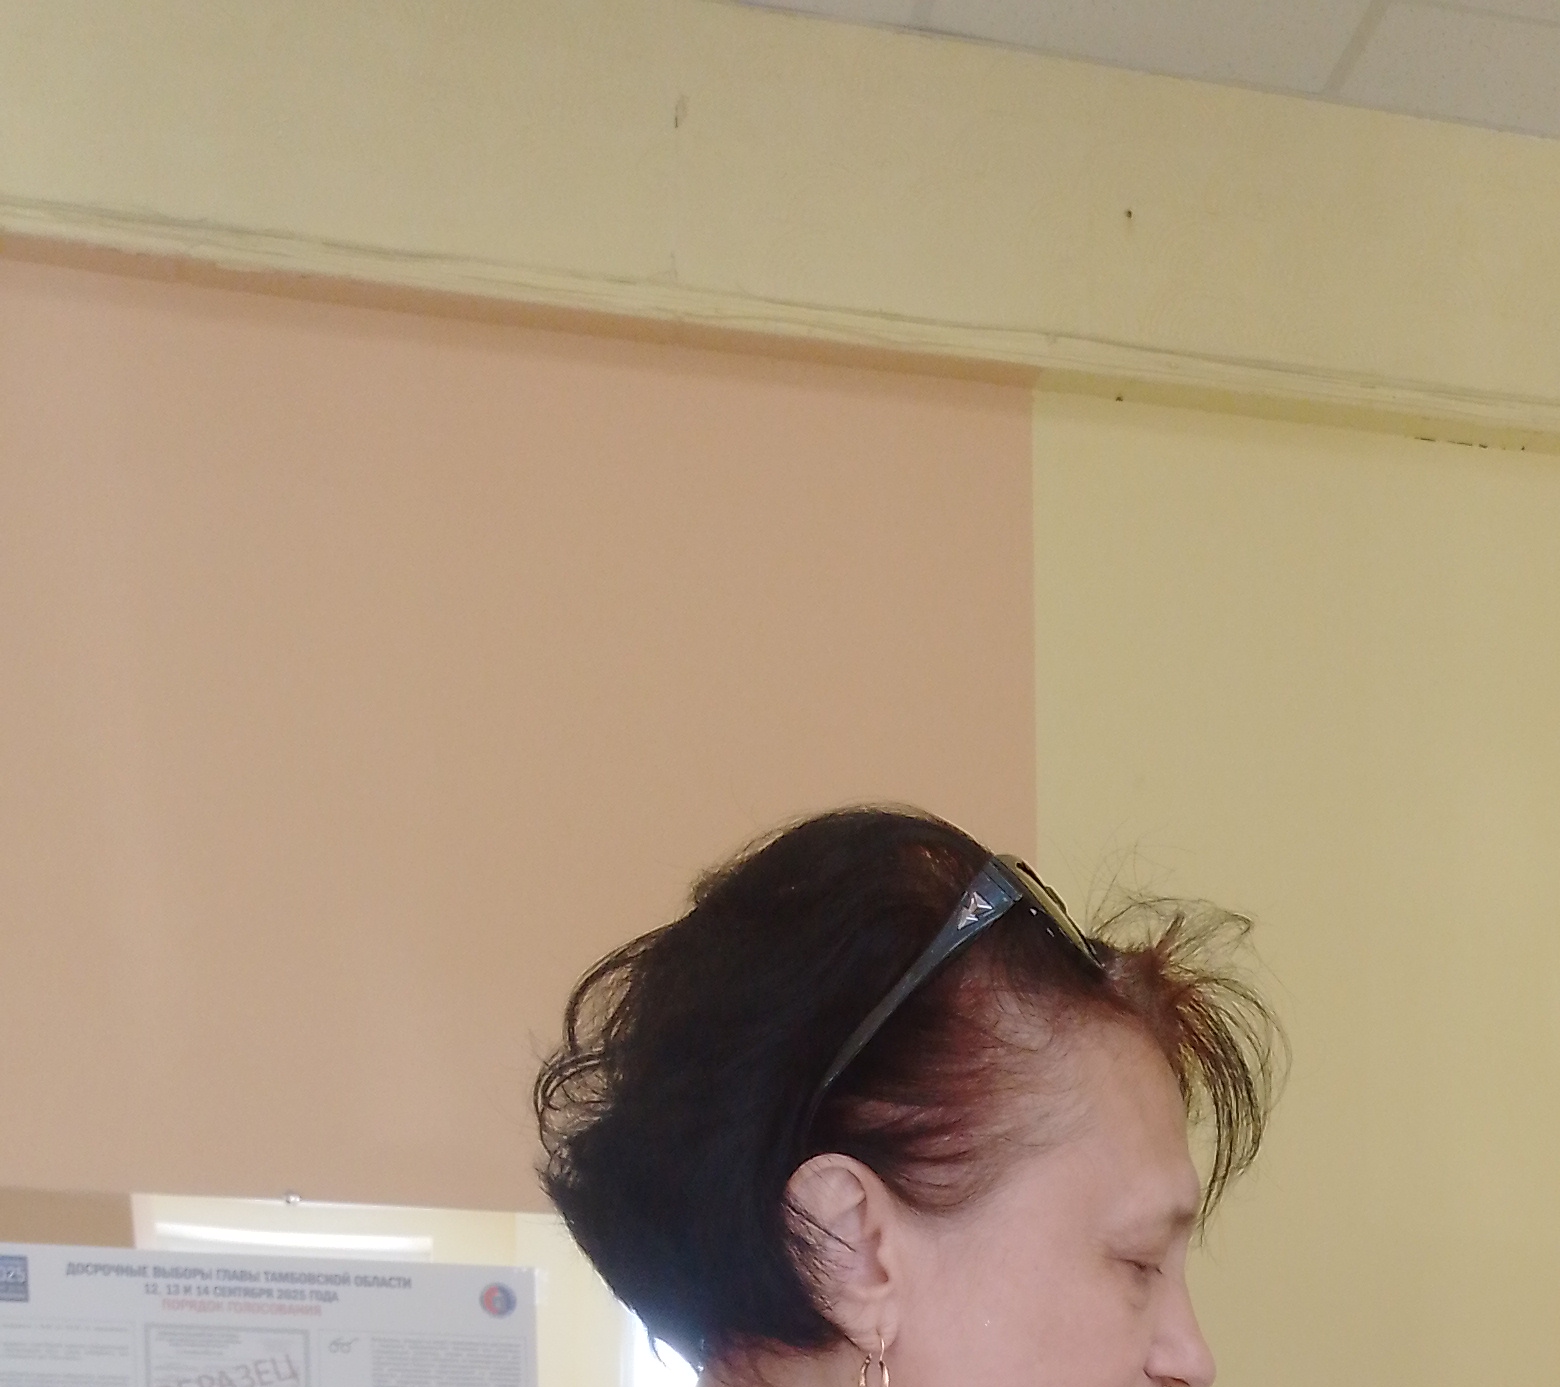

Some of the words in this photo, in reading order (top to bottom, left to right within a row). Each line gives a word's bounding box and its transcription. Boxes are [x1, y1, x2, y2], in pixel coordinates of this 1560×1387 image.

[66, 1261, 148, 1278] ДОСРОЧНЫЕ
[152, 1265, 213, 1281] ВЫБОРЫ
[216, 1267, 261, 1283] ГЛАВЫ
[263, 1270, 351, 1287] ТАМБОВСКОЙ
[353, 1274, 412, 1290] ОБЛАСТИ
[212, 1286, 274, 1300] СЕНТЯБРЯ
[308, 1289, 340, 1304] ГОДА
